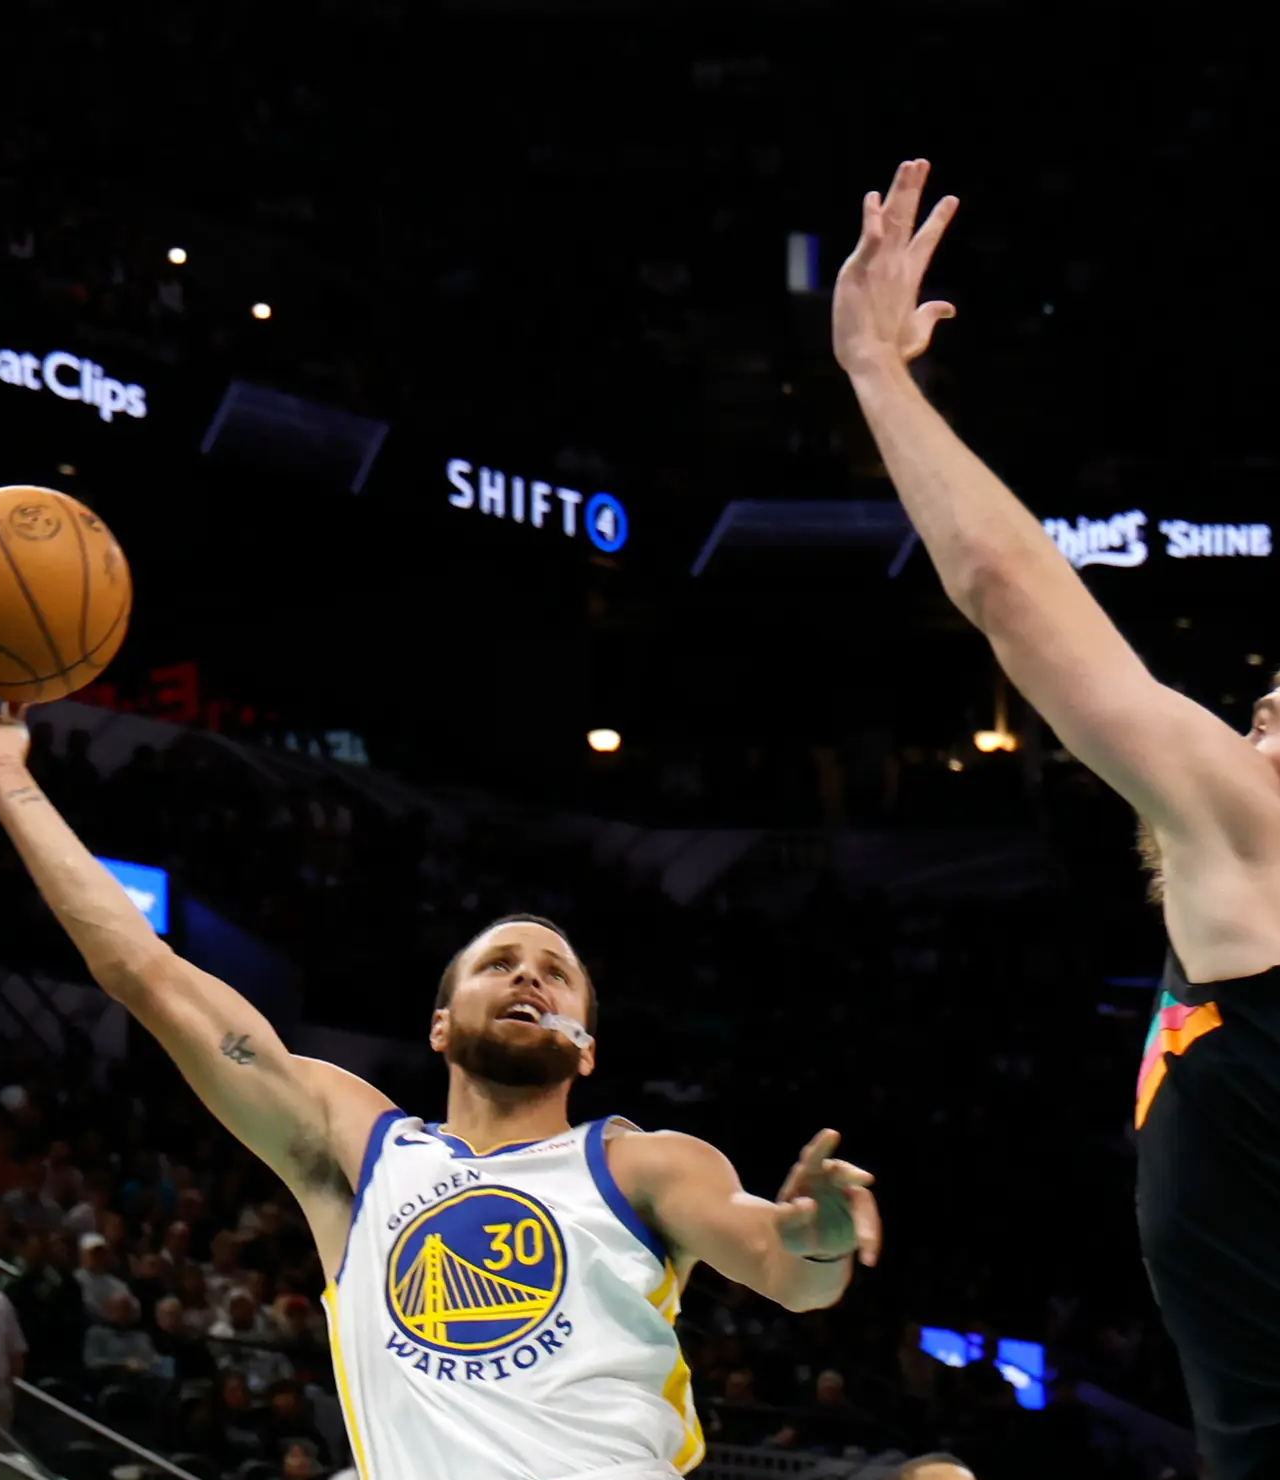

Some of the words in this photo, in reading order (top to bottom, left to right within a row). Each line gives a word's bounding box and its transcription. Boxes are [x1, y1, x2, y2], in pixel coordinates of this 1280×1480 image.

[42, 350, 148, 423] Clips
[446, 457, 583, 537] SHIFT
[387, 1169, 482, 1232] GOLDEN
[482, 1218, 544, 1272] 30
[385, 1311, 575, 1383] WARRIORS
